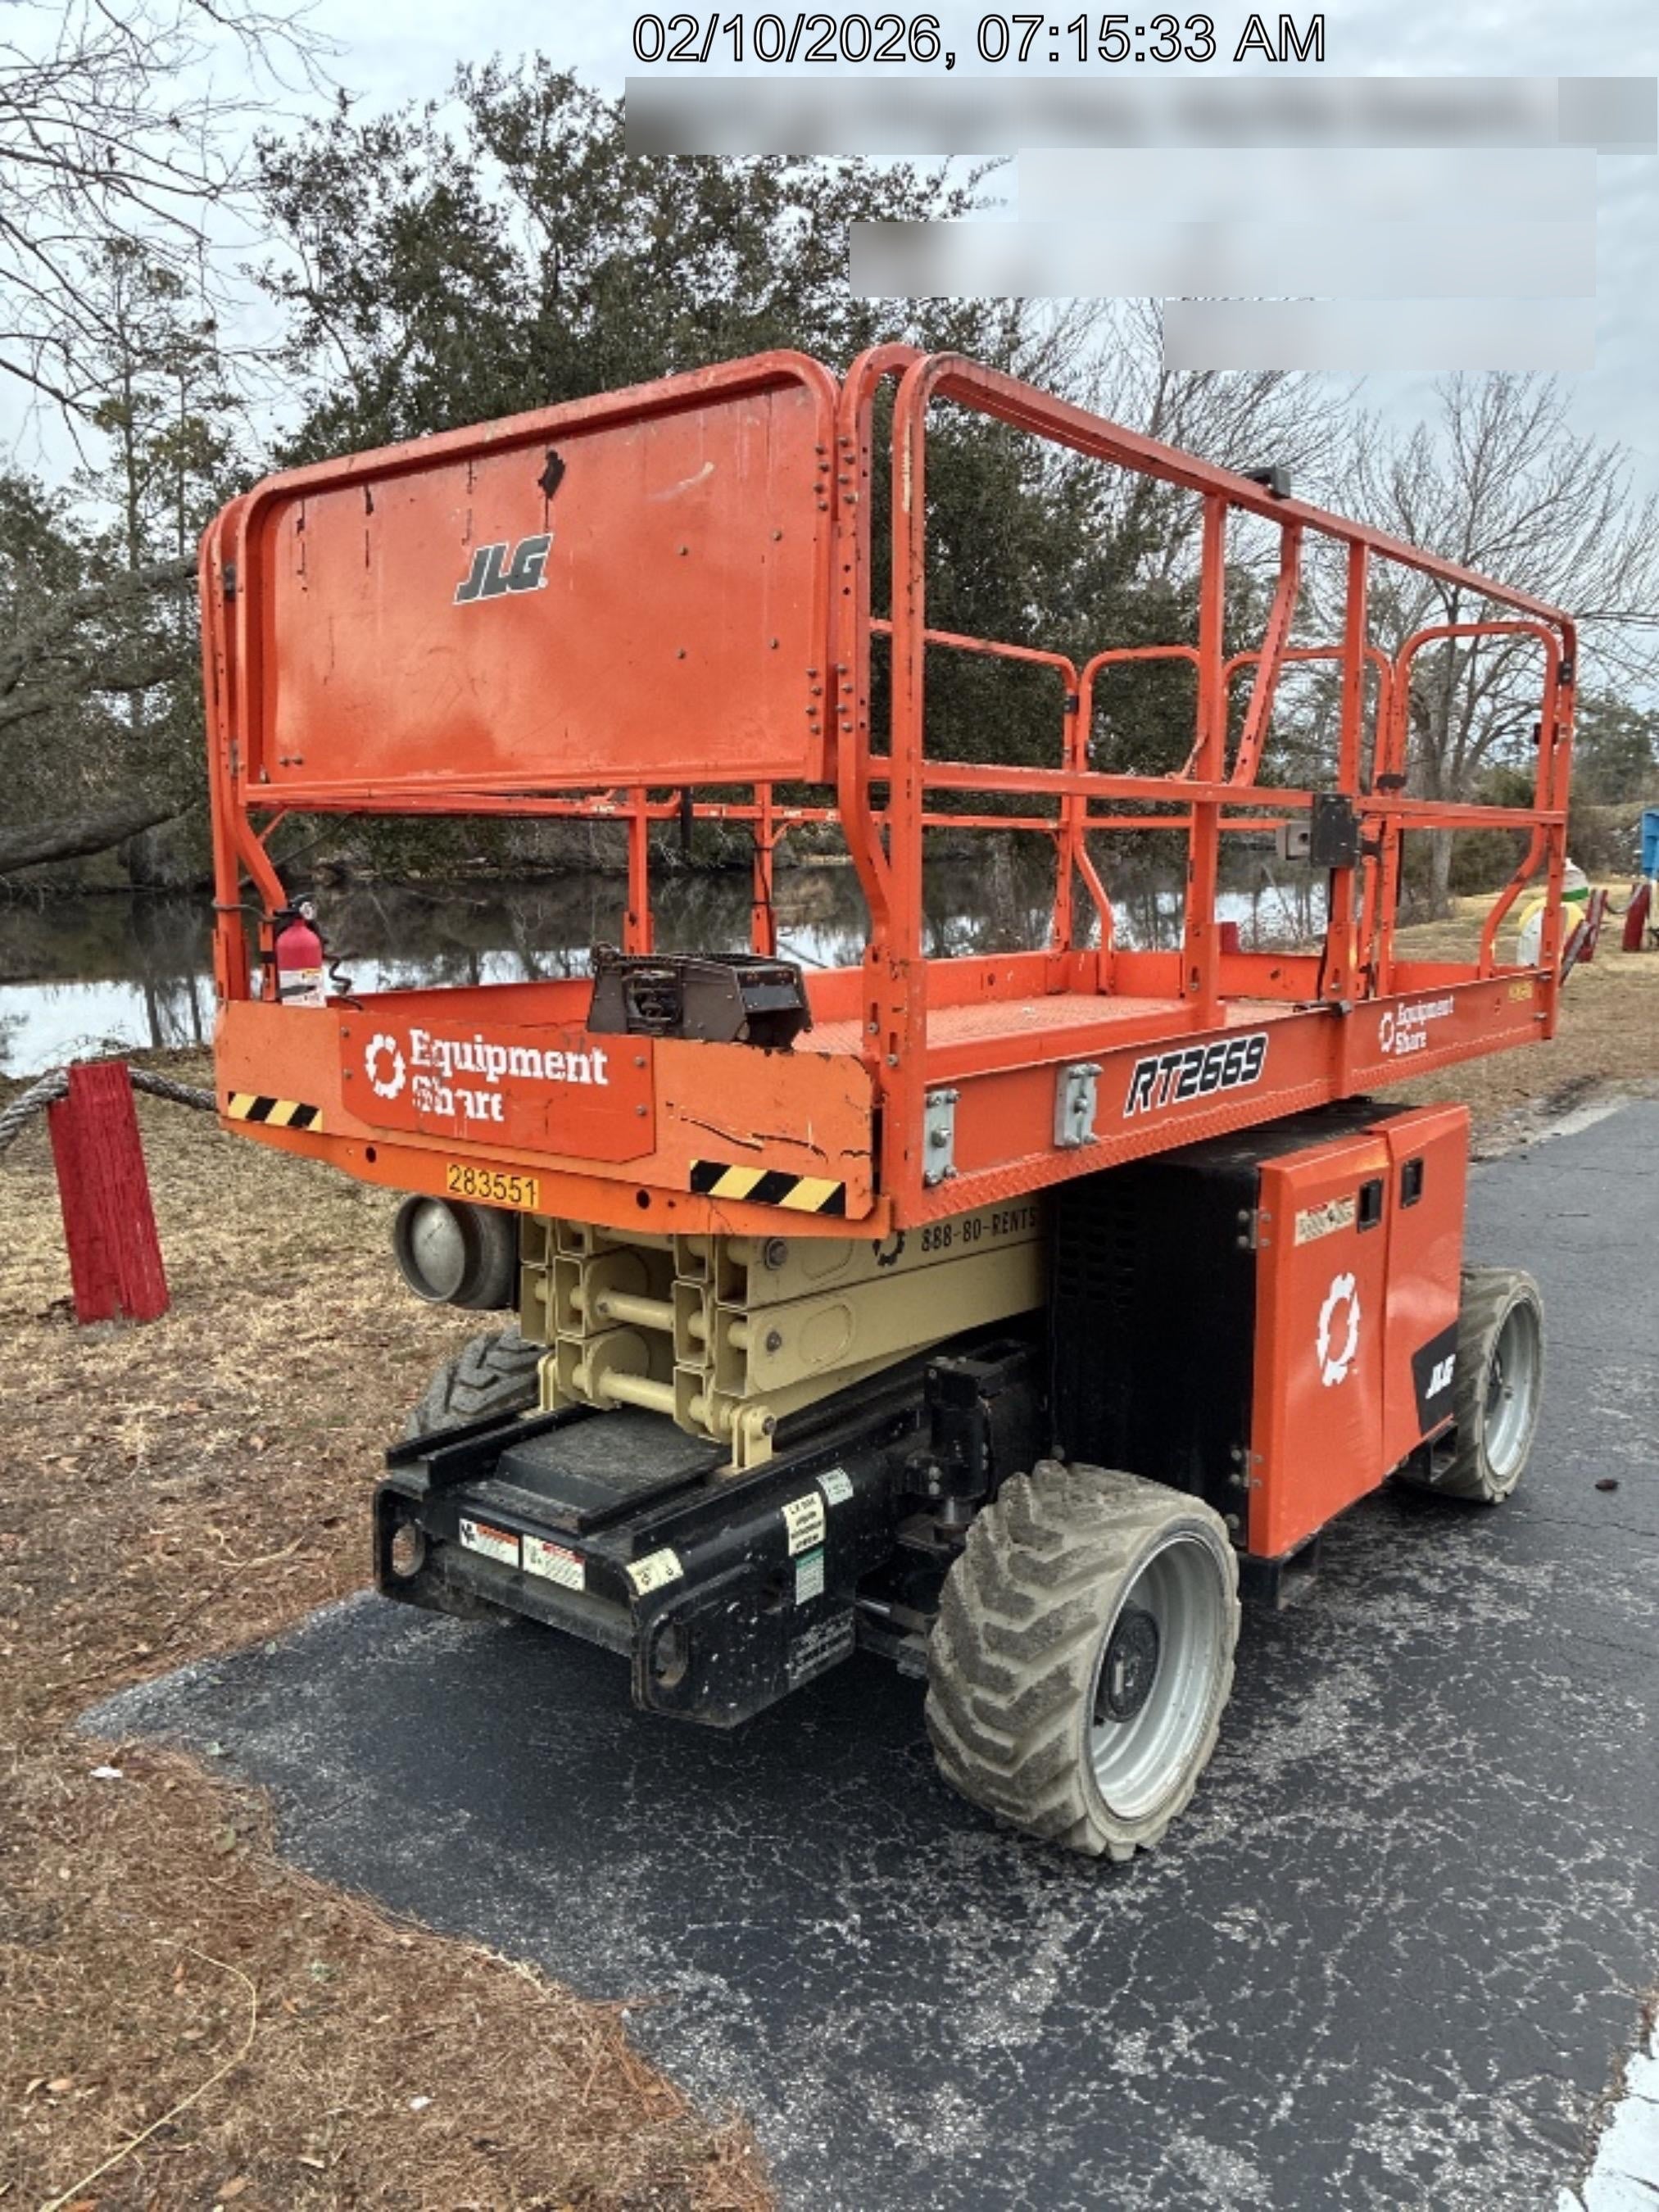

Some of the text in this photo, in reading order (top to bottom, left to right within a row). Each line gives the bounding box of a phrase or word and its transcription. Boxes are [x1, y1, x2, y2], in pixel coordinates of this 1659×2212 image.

[452, 533, 553, 605] JLG
[1396, 995, 1455, 1030] Equipment
[410, 1029, 608, 1085] Equipment
[1395, 1029, 1427, 1055] Share
[1123, 1031, 1268, 1118] RT2669
[448, 1164, 536, 1206] 283551
